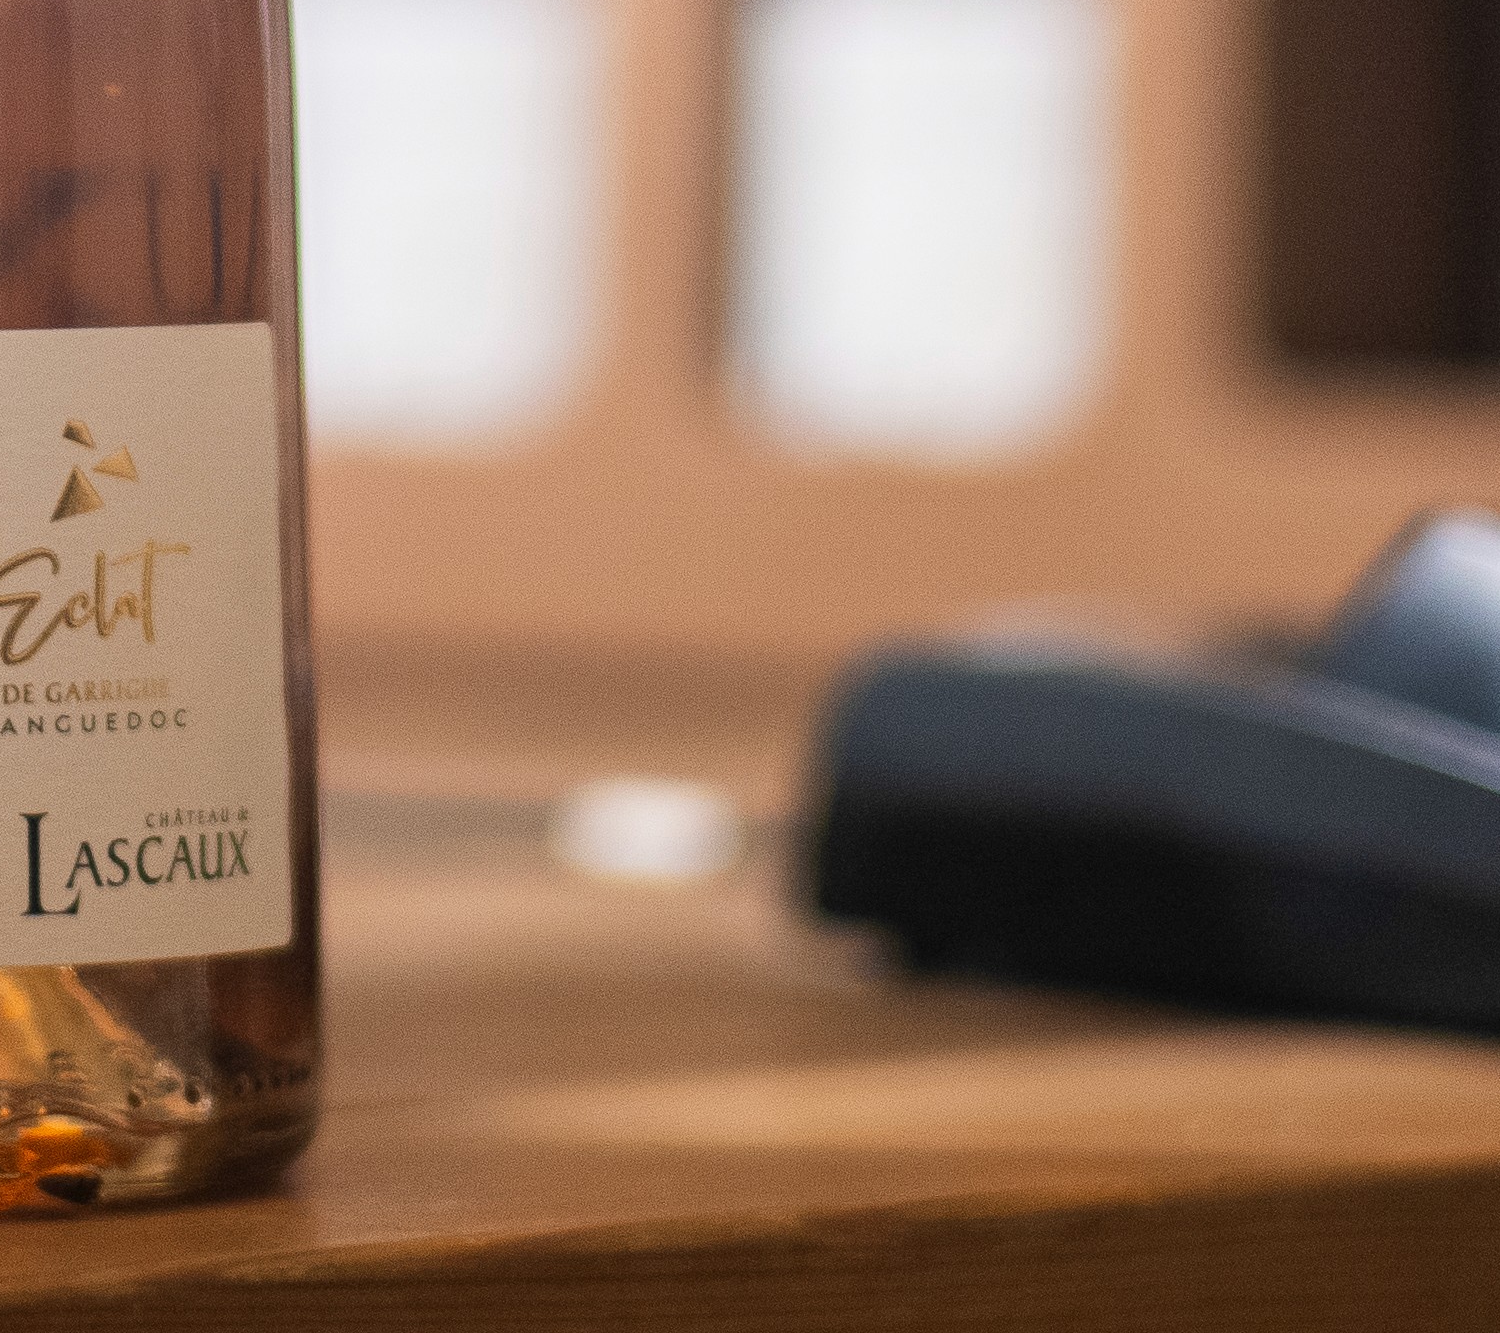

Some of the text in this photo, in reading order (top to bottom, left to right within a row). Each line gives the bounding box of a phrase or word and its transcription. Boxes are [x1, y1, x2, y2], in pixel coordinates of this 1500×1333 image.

[2, 682, 34, 705] DE
[145, 807, 229, 829] CHÂTEAU
[19, 811, 250, 916] LASCAUX
